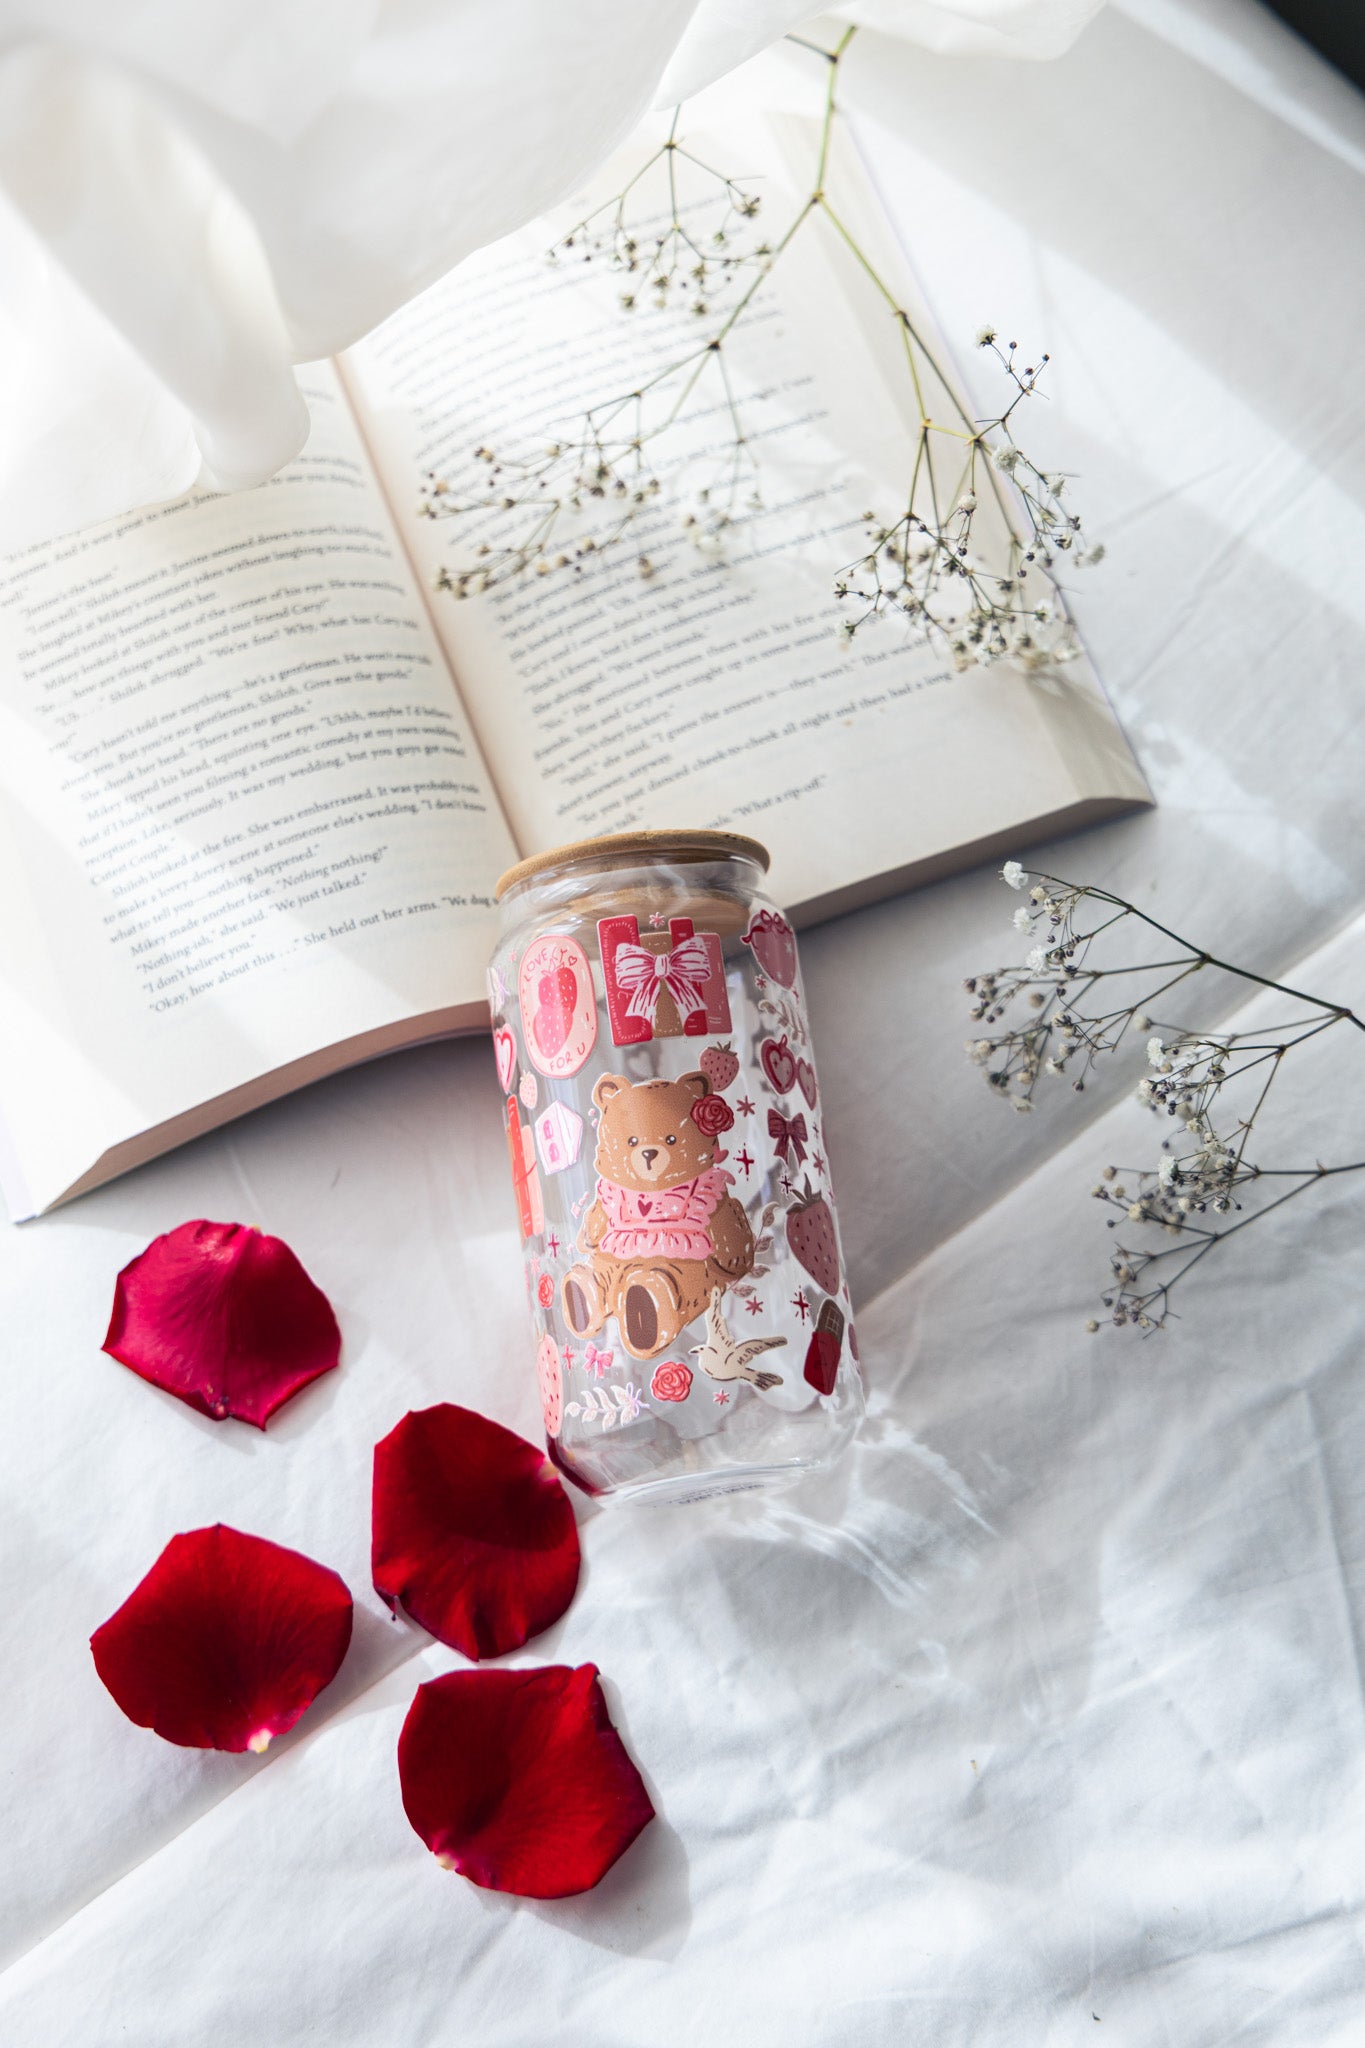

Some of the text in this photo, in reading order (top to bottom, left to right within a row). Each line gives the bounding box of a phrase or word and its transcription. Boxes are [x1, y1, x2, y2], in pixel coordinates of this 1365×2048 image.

[251, 717, 268, 730] no
[269, 729, 293, 744] one
[227, 789, 240, 802] It
[241, 781, 265, 796] was
[267, 772, 287, 787] my
[201, 842, 222, 856] the
[247, 822, 270, 837] She
[271, 813, 296, 827] was
[262, 840, 276, 853] at
[276, 823, 330, 847] someone
[137, 919, 151, 933] to
[168, 917, 200, 939] made
[201, 897, 246, 924] another
[219, 922, 239, 938] she
[297, 889, 320, 908] just
[184, 951, 226, 976] believe
[188, 979, 214, 997] how
[217, 962, 250, 984] about
[251, 951, 276, 968] this
[303, 931, 328, 946] She
[328, 917, 357, 937] held
[359, 913, 380, 927] out
[381, 908, 403, 921] her
[549, 1042, 586, 1072] FOR U
